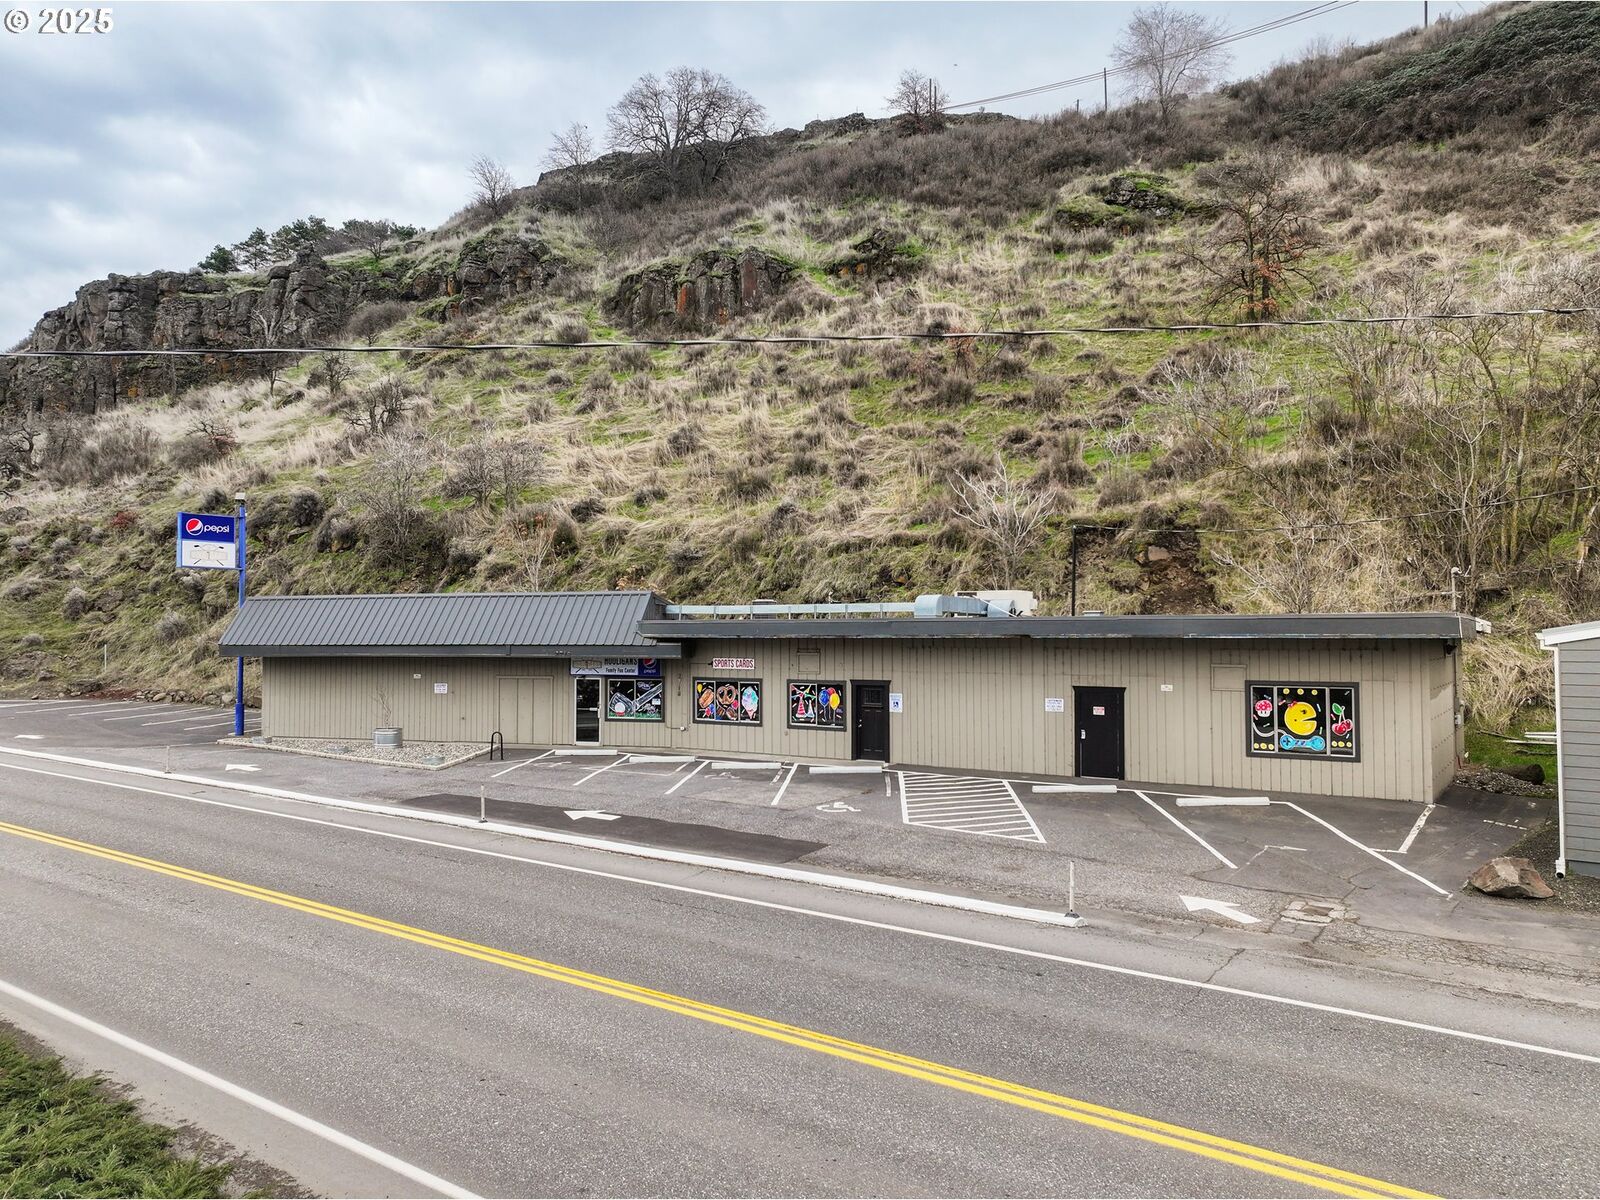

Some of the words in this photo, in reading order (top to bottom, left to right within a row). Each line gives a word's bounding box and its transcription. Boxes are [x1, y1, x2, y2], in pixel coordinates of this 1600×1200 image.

[204, 524, 230, 534] pepsi
[714, 658, 734, 668] SPORTS
[735, 658, 754, 669] CARDS
